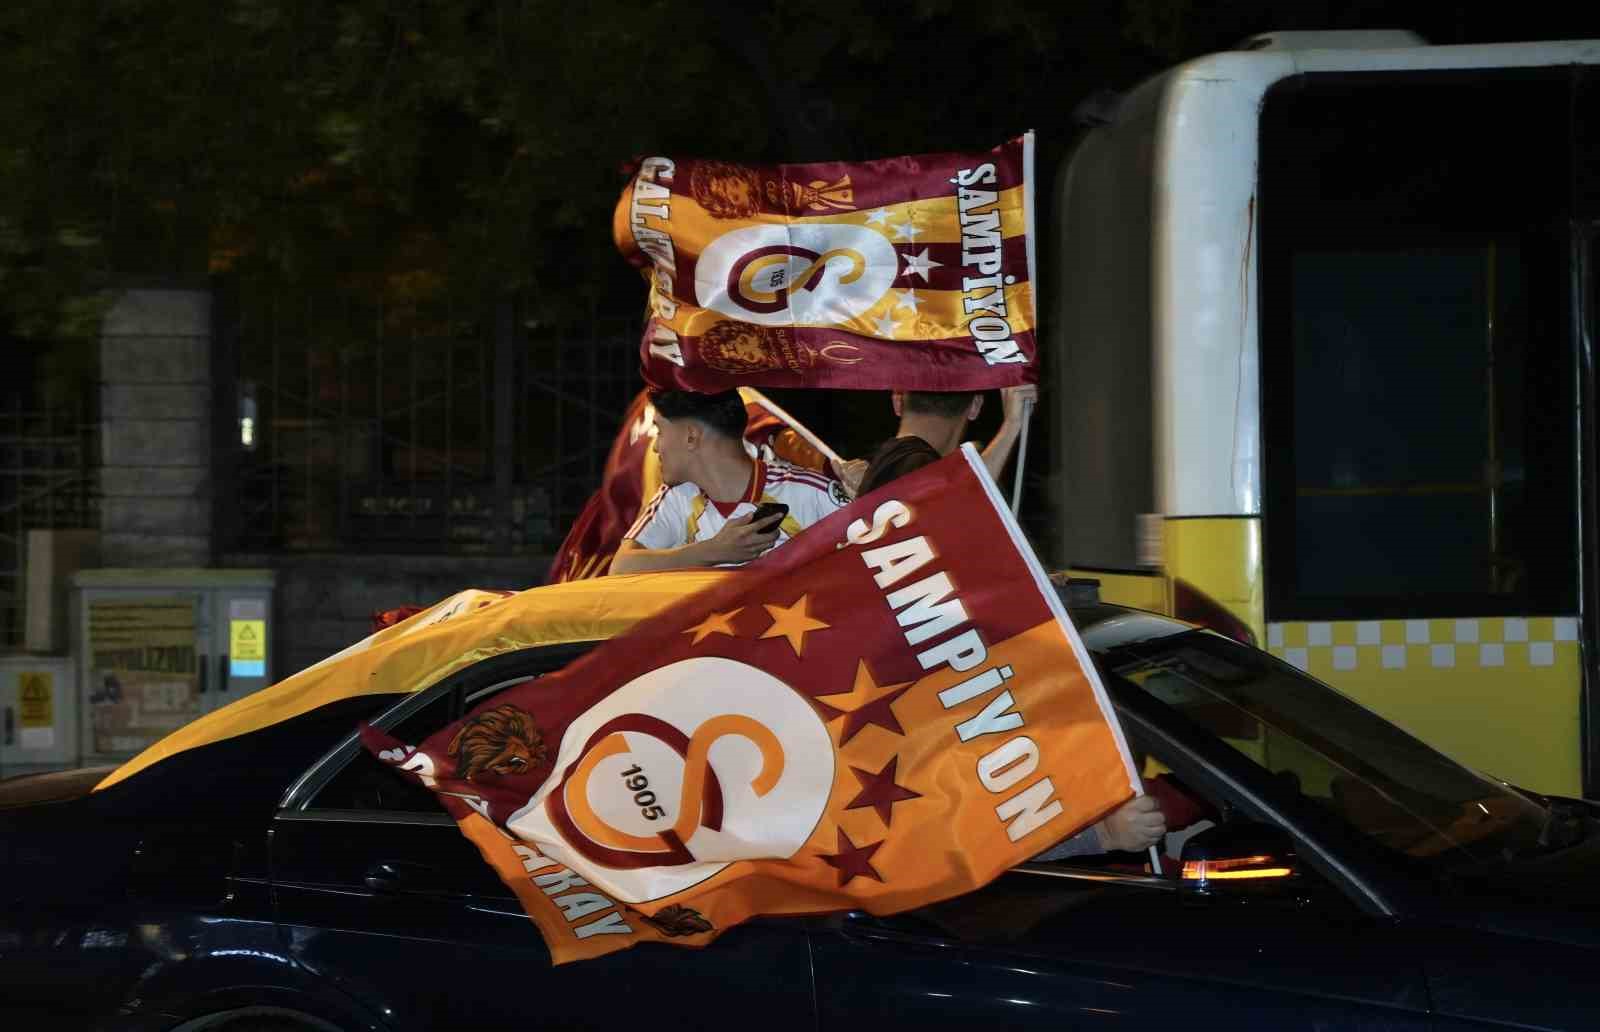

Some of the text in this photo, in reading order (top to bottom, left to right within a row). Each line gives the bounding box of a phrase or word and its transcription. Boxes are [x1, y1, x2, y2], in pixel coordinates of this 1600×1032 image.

[950, 162, 1030, 367] ŞAMPİYON
[836, 499, 1064, 843] ŞAMPİYON
[620, 763, 666, 822] 1905
